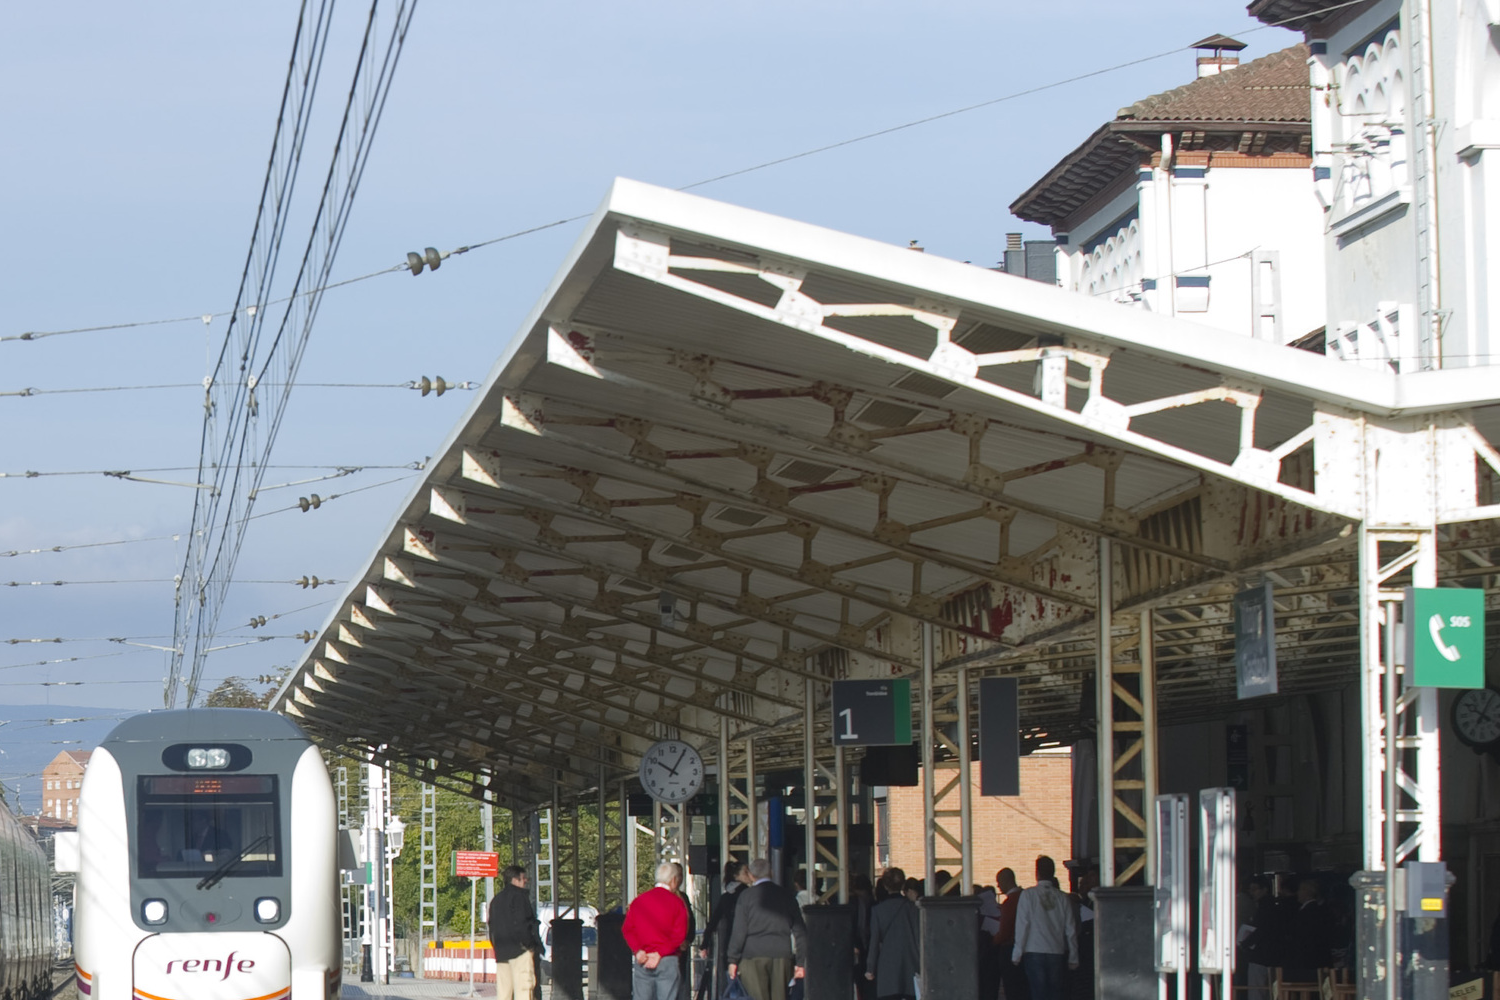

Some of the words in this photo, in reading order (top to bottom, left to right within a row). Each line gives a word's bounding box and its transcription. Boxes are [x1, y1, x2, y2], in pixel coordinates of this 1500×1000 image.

[1449, 615, 1472, 628] SOS
[838, 708, 858, 740] 1
[669, 746, 677, 754] 12
[690, 757, 696, 765] 2
[693, 768, 698, 776] 3
[689, 779, 695, 787] 4
[659, 787, 664, 797] 7
[681, 788, 687, 796] 5
[347, 871, 354, 883] 1
[166, 950, 256, 982] renfe
